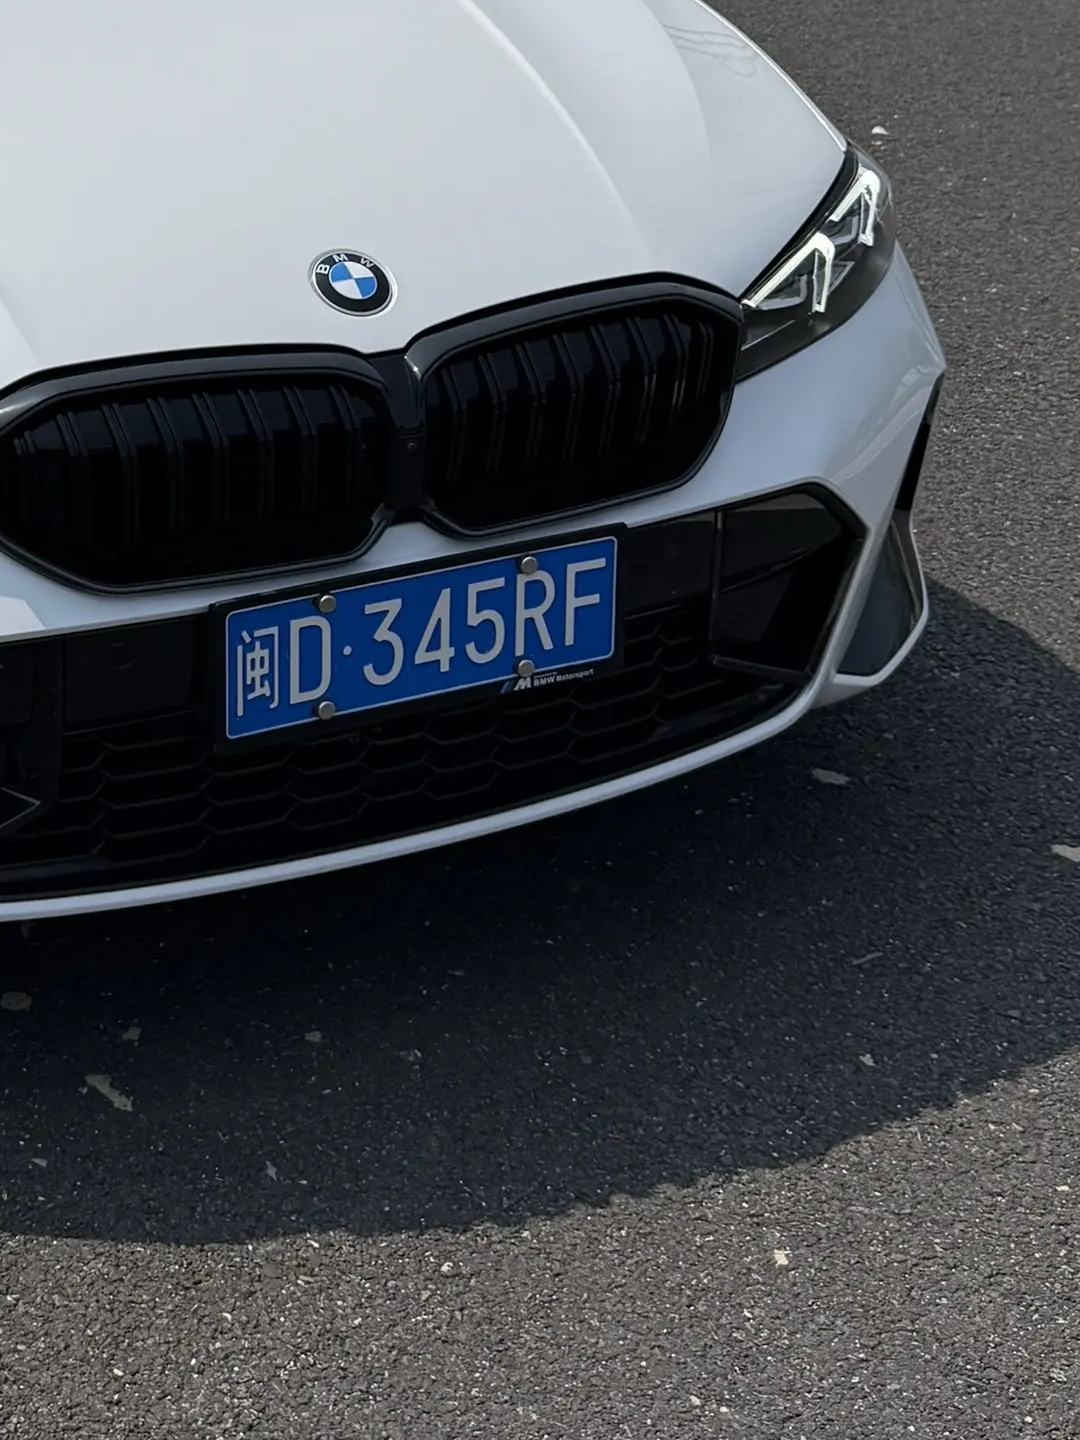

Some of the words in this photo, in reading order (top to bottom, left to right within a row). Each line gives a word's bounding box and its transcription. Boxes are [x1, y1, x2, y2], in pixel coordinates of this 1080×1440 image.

[316, 253, 375, 275] BMW
[533, 675, 556, 687] BMW
[556, 668, 595, 682] Motorsport
